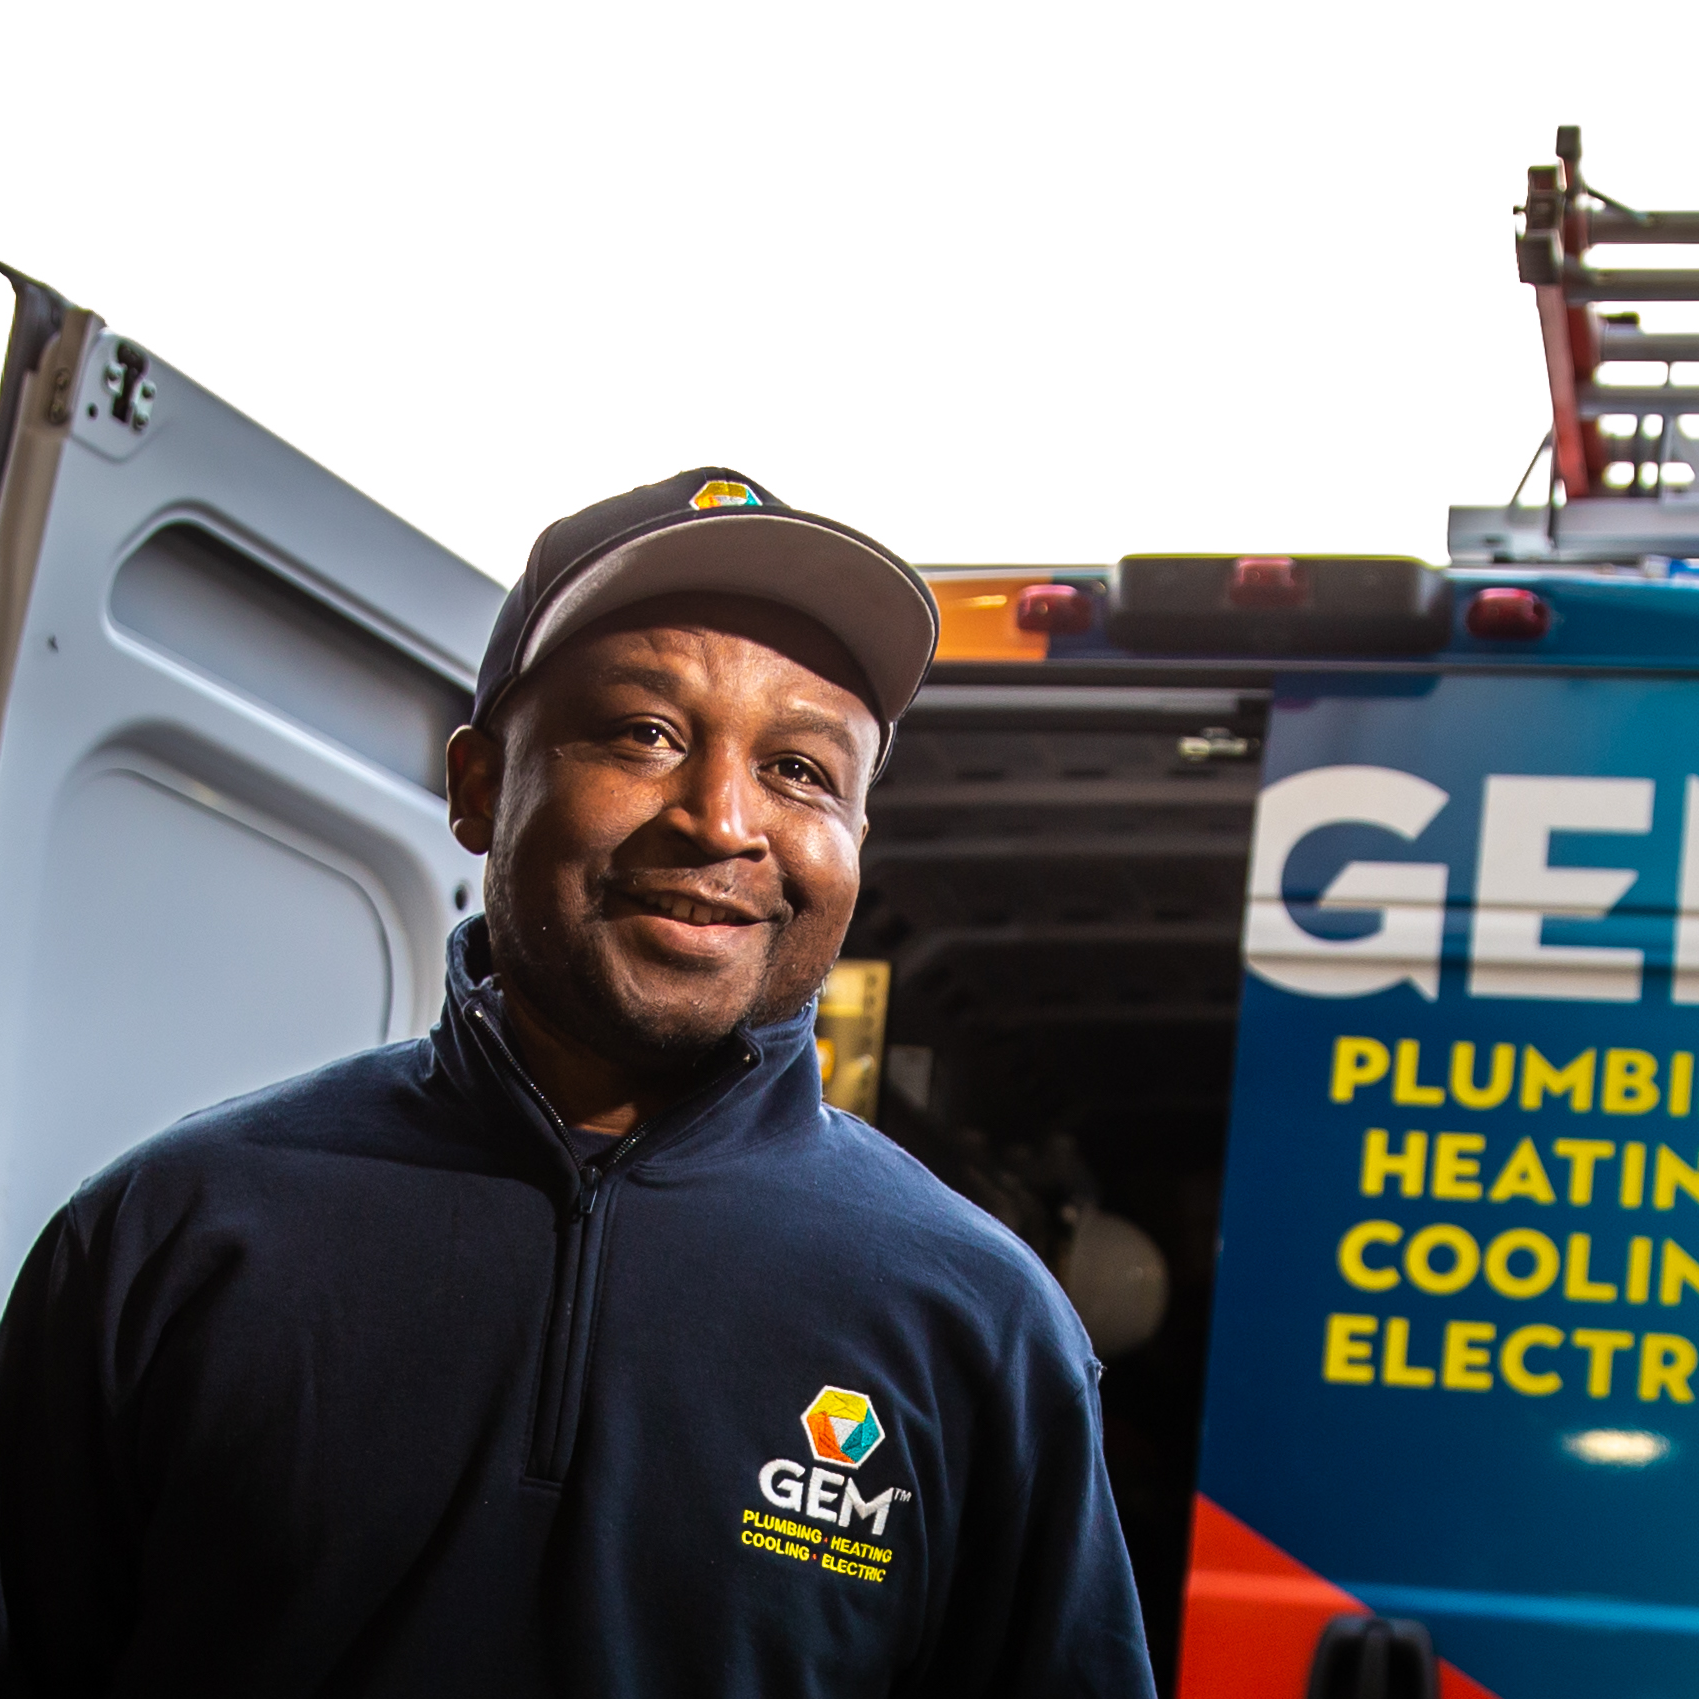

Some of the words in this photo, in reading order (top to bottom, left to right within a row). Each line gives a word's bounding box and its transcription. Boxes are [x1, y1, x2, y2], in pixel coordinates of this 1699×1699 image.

[758, 1458, 895, 1536] GEM
[741, 1530, 810, 1561] COOLING
[821, 1553, 886, 1583] ELECTRIC
[742, 1509, 822, 1544] PLUMBING
[830, 1535, 893, 1564] HEATING
